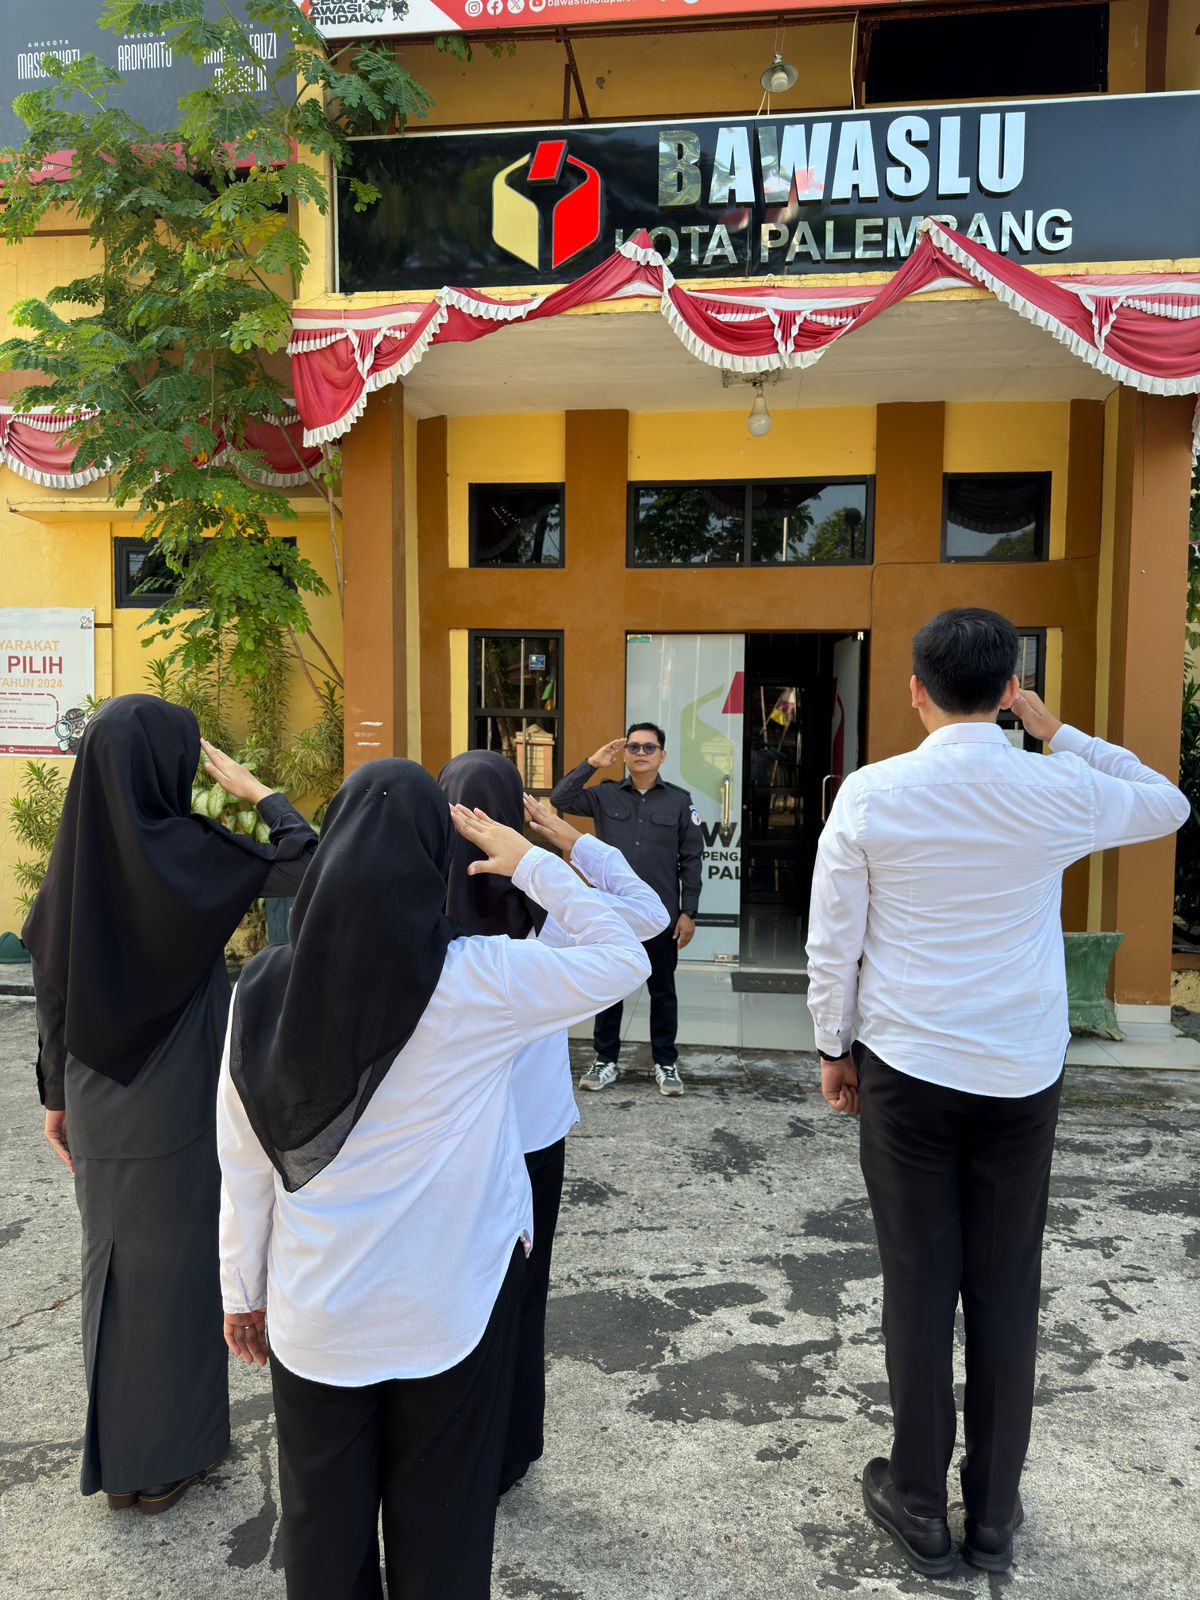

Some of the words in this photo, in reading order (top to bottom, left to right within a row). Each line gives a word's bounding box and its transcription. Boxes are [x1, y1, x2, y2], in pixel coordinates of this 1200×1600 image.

[310, 4, 362, 16] AWASI
[311, 13, 371, 26] TINDAK
[27, 39, 69, 47] ANGGOTA
[117, 41, 172, 71] ARDIYANTO
[658, 111, 1026, 207] BAWASLU
[7, 655, 63, 674] PILIH
[37, 677, 63, 689] 2024
[702, 851, 741, 862] PENG
